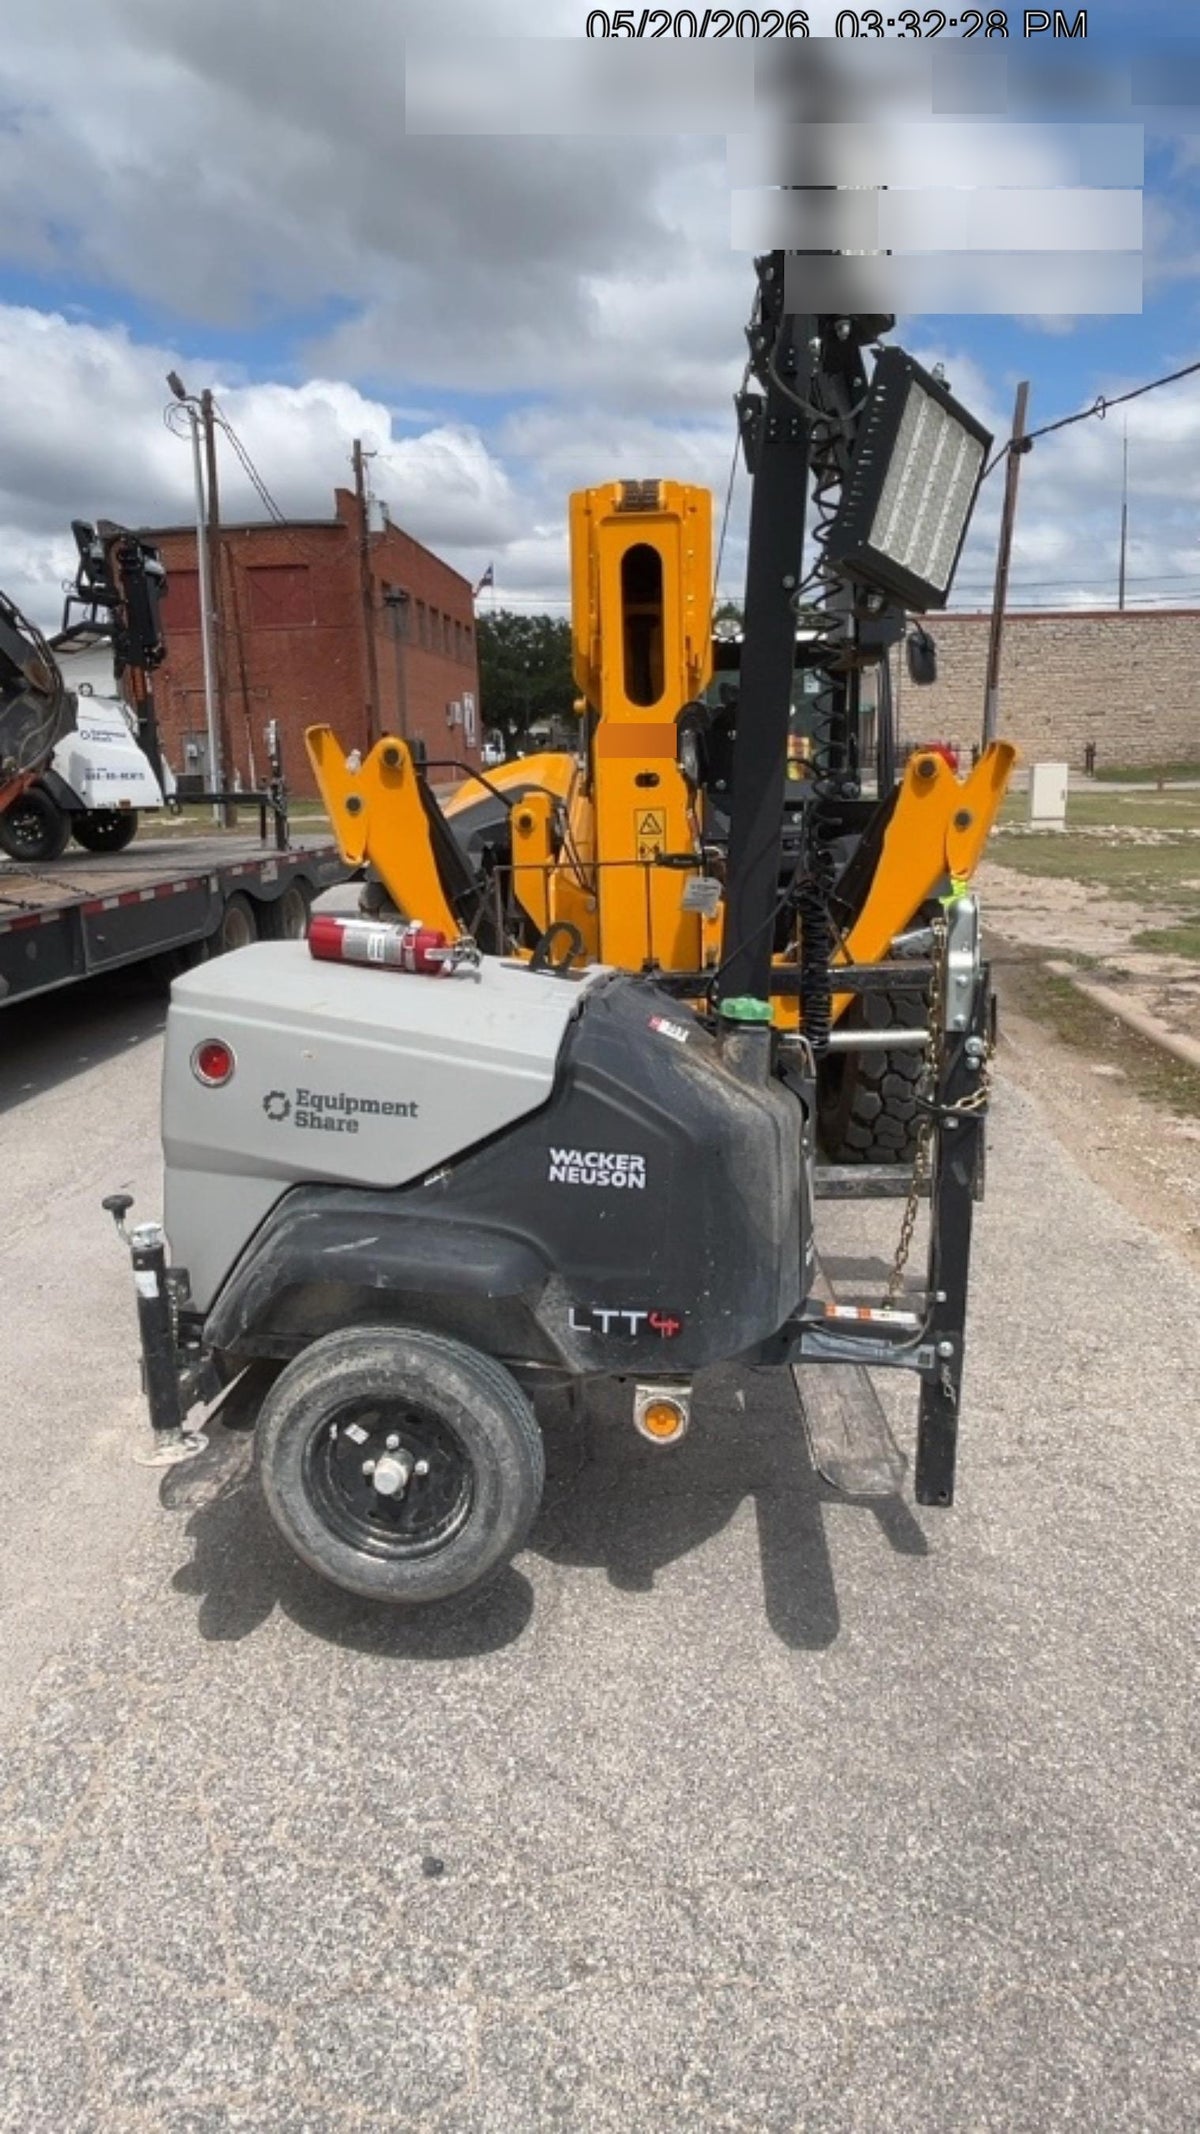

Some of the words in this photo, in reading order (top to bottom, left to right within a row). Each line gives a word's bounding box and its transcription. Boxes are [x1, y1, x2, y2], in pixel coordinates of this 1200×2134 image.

[295, 1088, 419, 1118] Equipment
[294, 1110, 360, 1134] Share
[549, 1147, 646, 1172] WACKER
[549, 1165, 646, 1189] NEUSON
